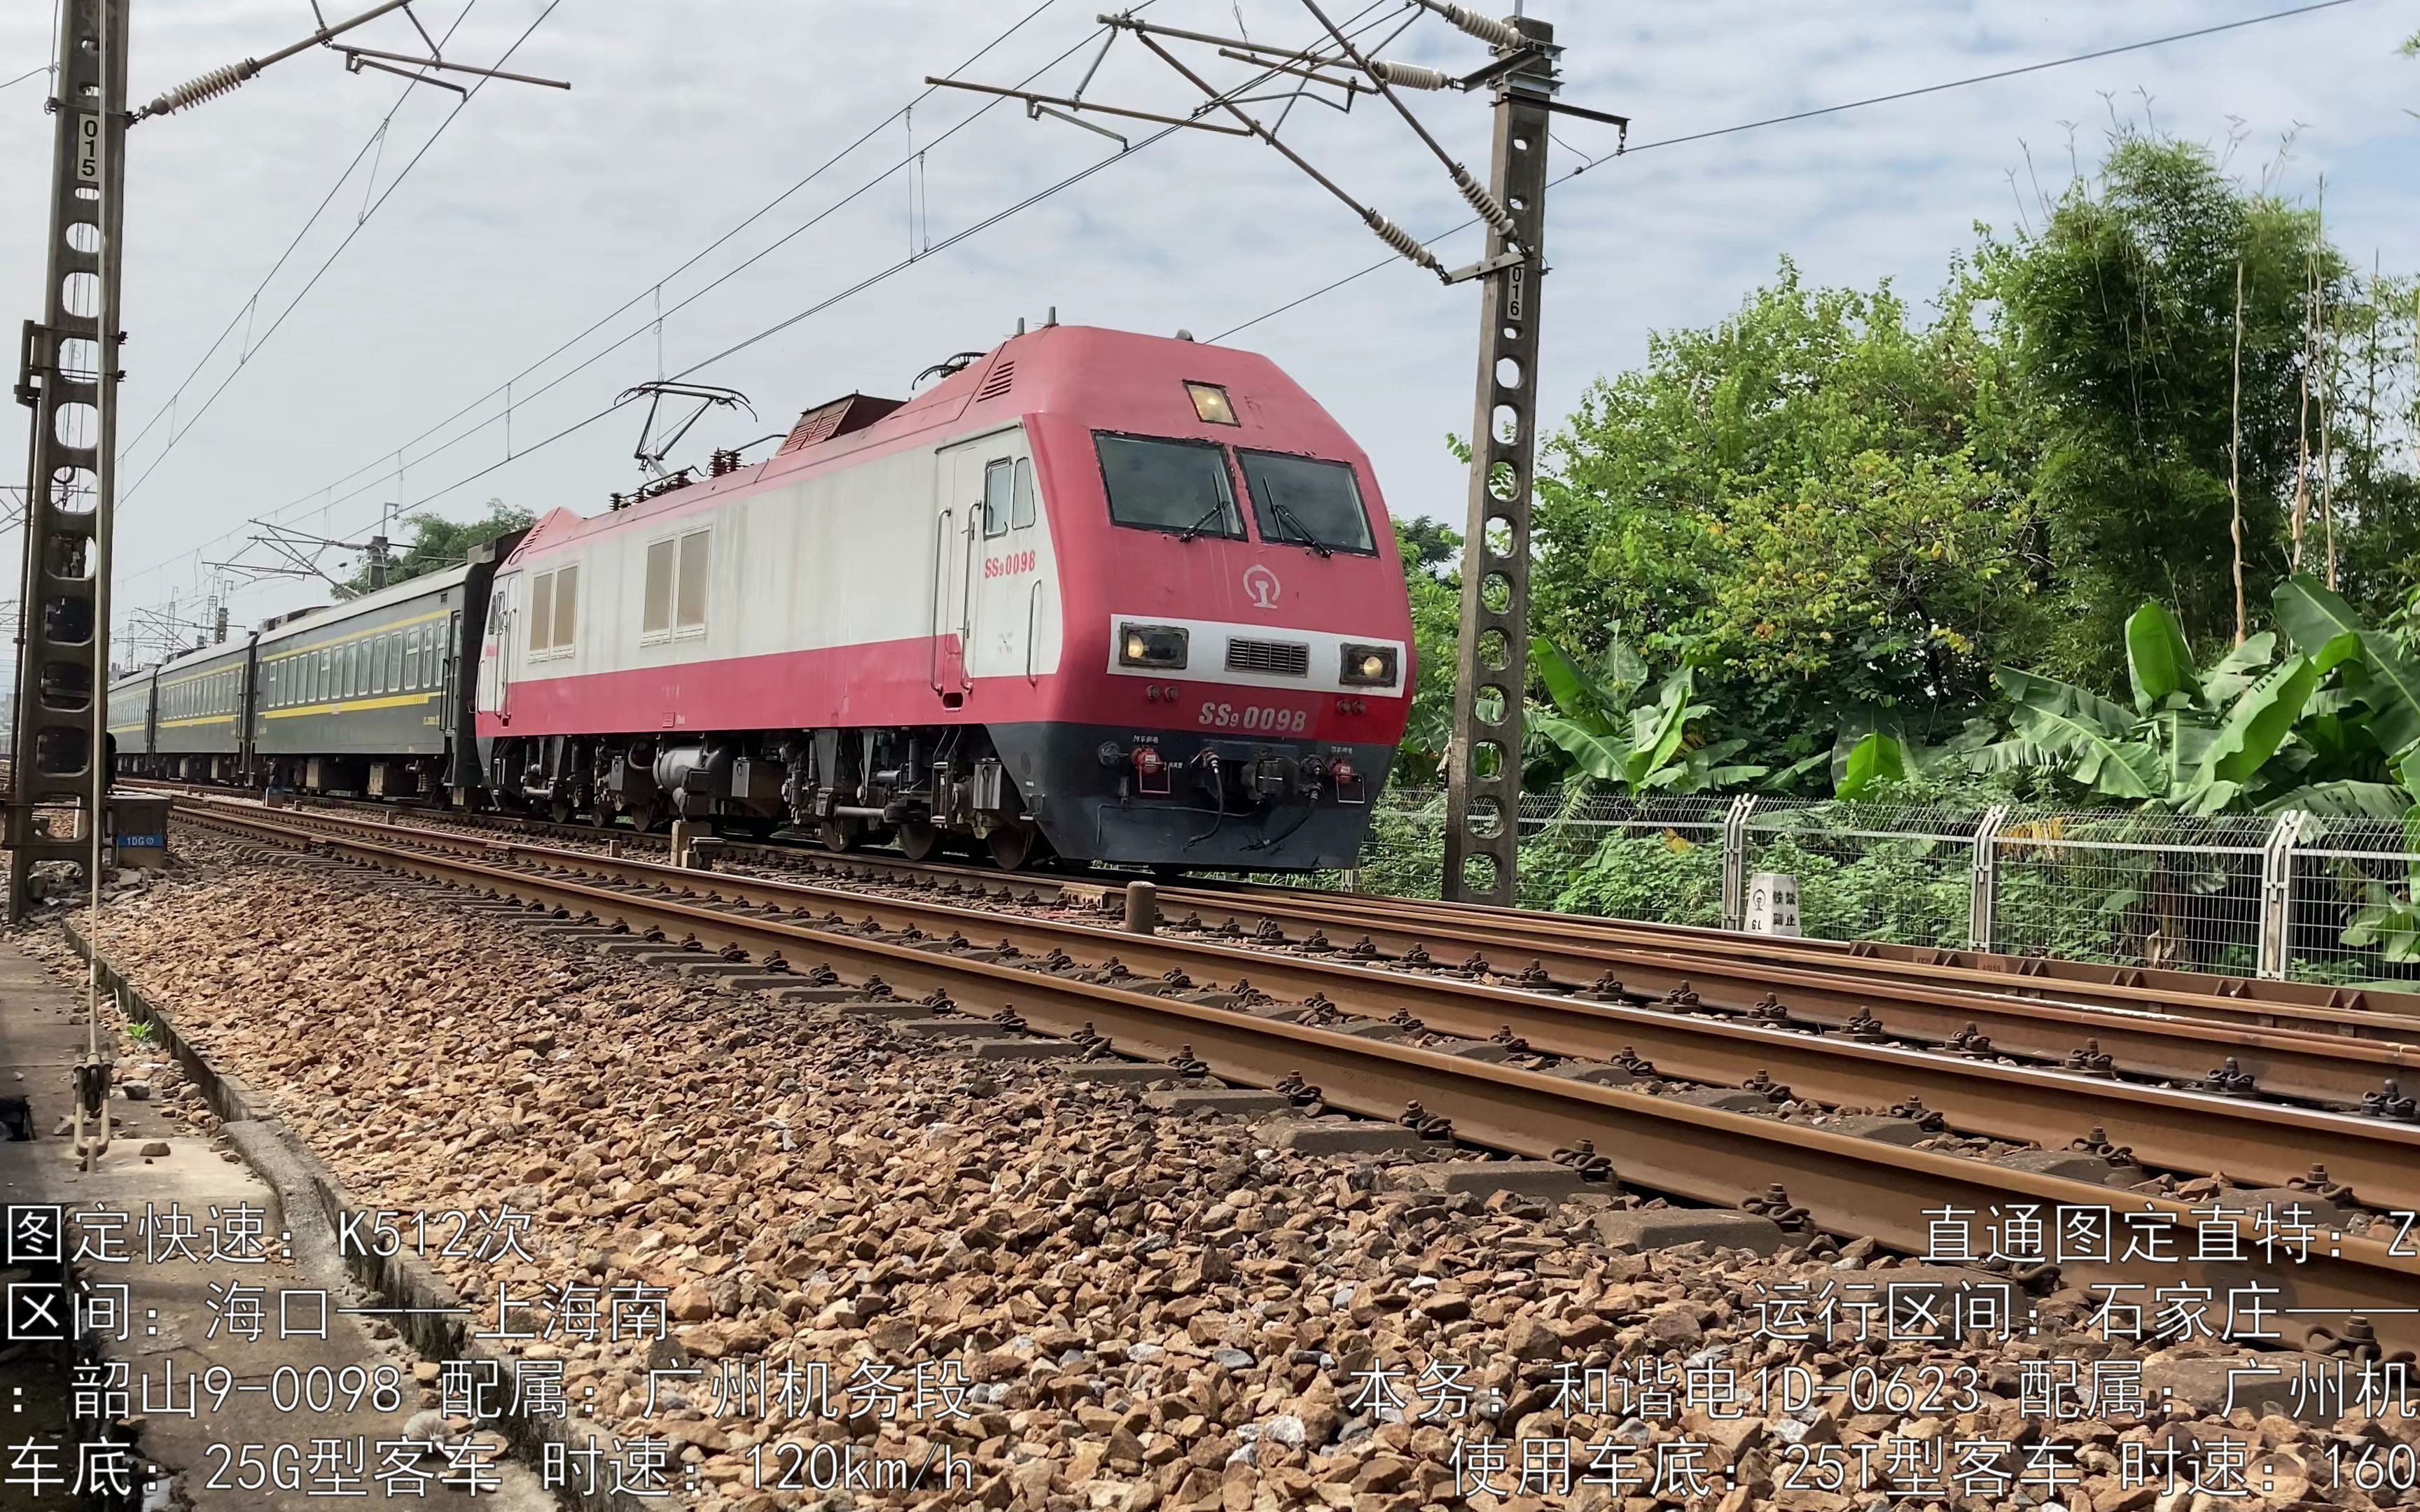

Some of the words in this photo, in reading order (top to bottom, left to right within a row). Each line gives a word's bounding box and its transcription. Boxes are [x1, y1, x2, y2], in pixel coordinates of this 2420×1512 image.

[82, 119, 99, 177] 015
[1510, 267, 1522, 316] 016
[1006, 550, 1036, 575] 0098
[1243, 706, 1307, 732] 0098
